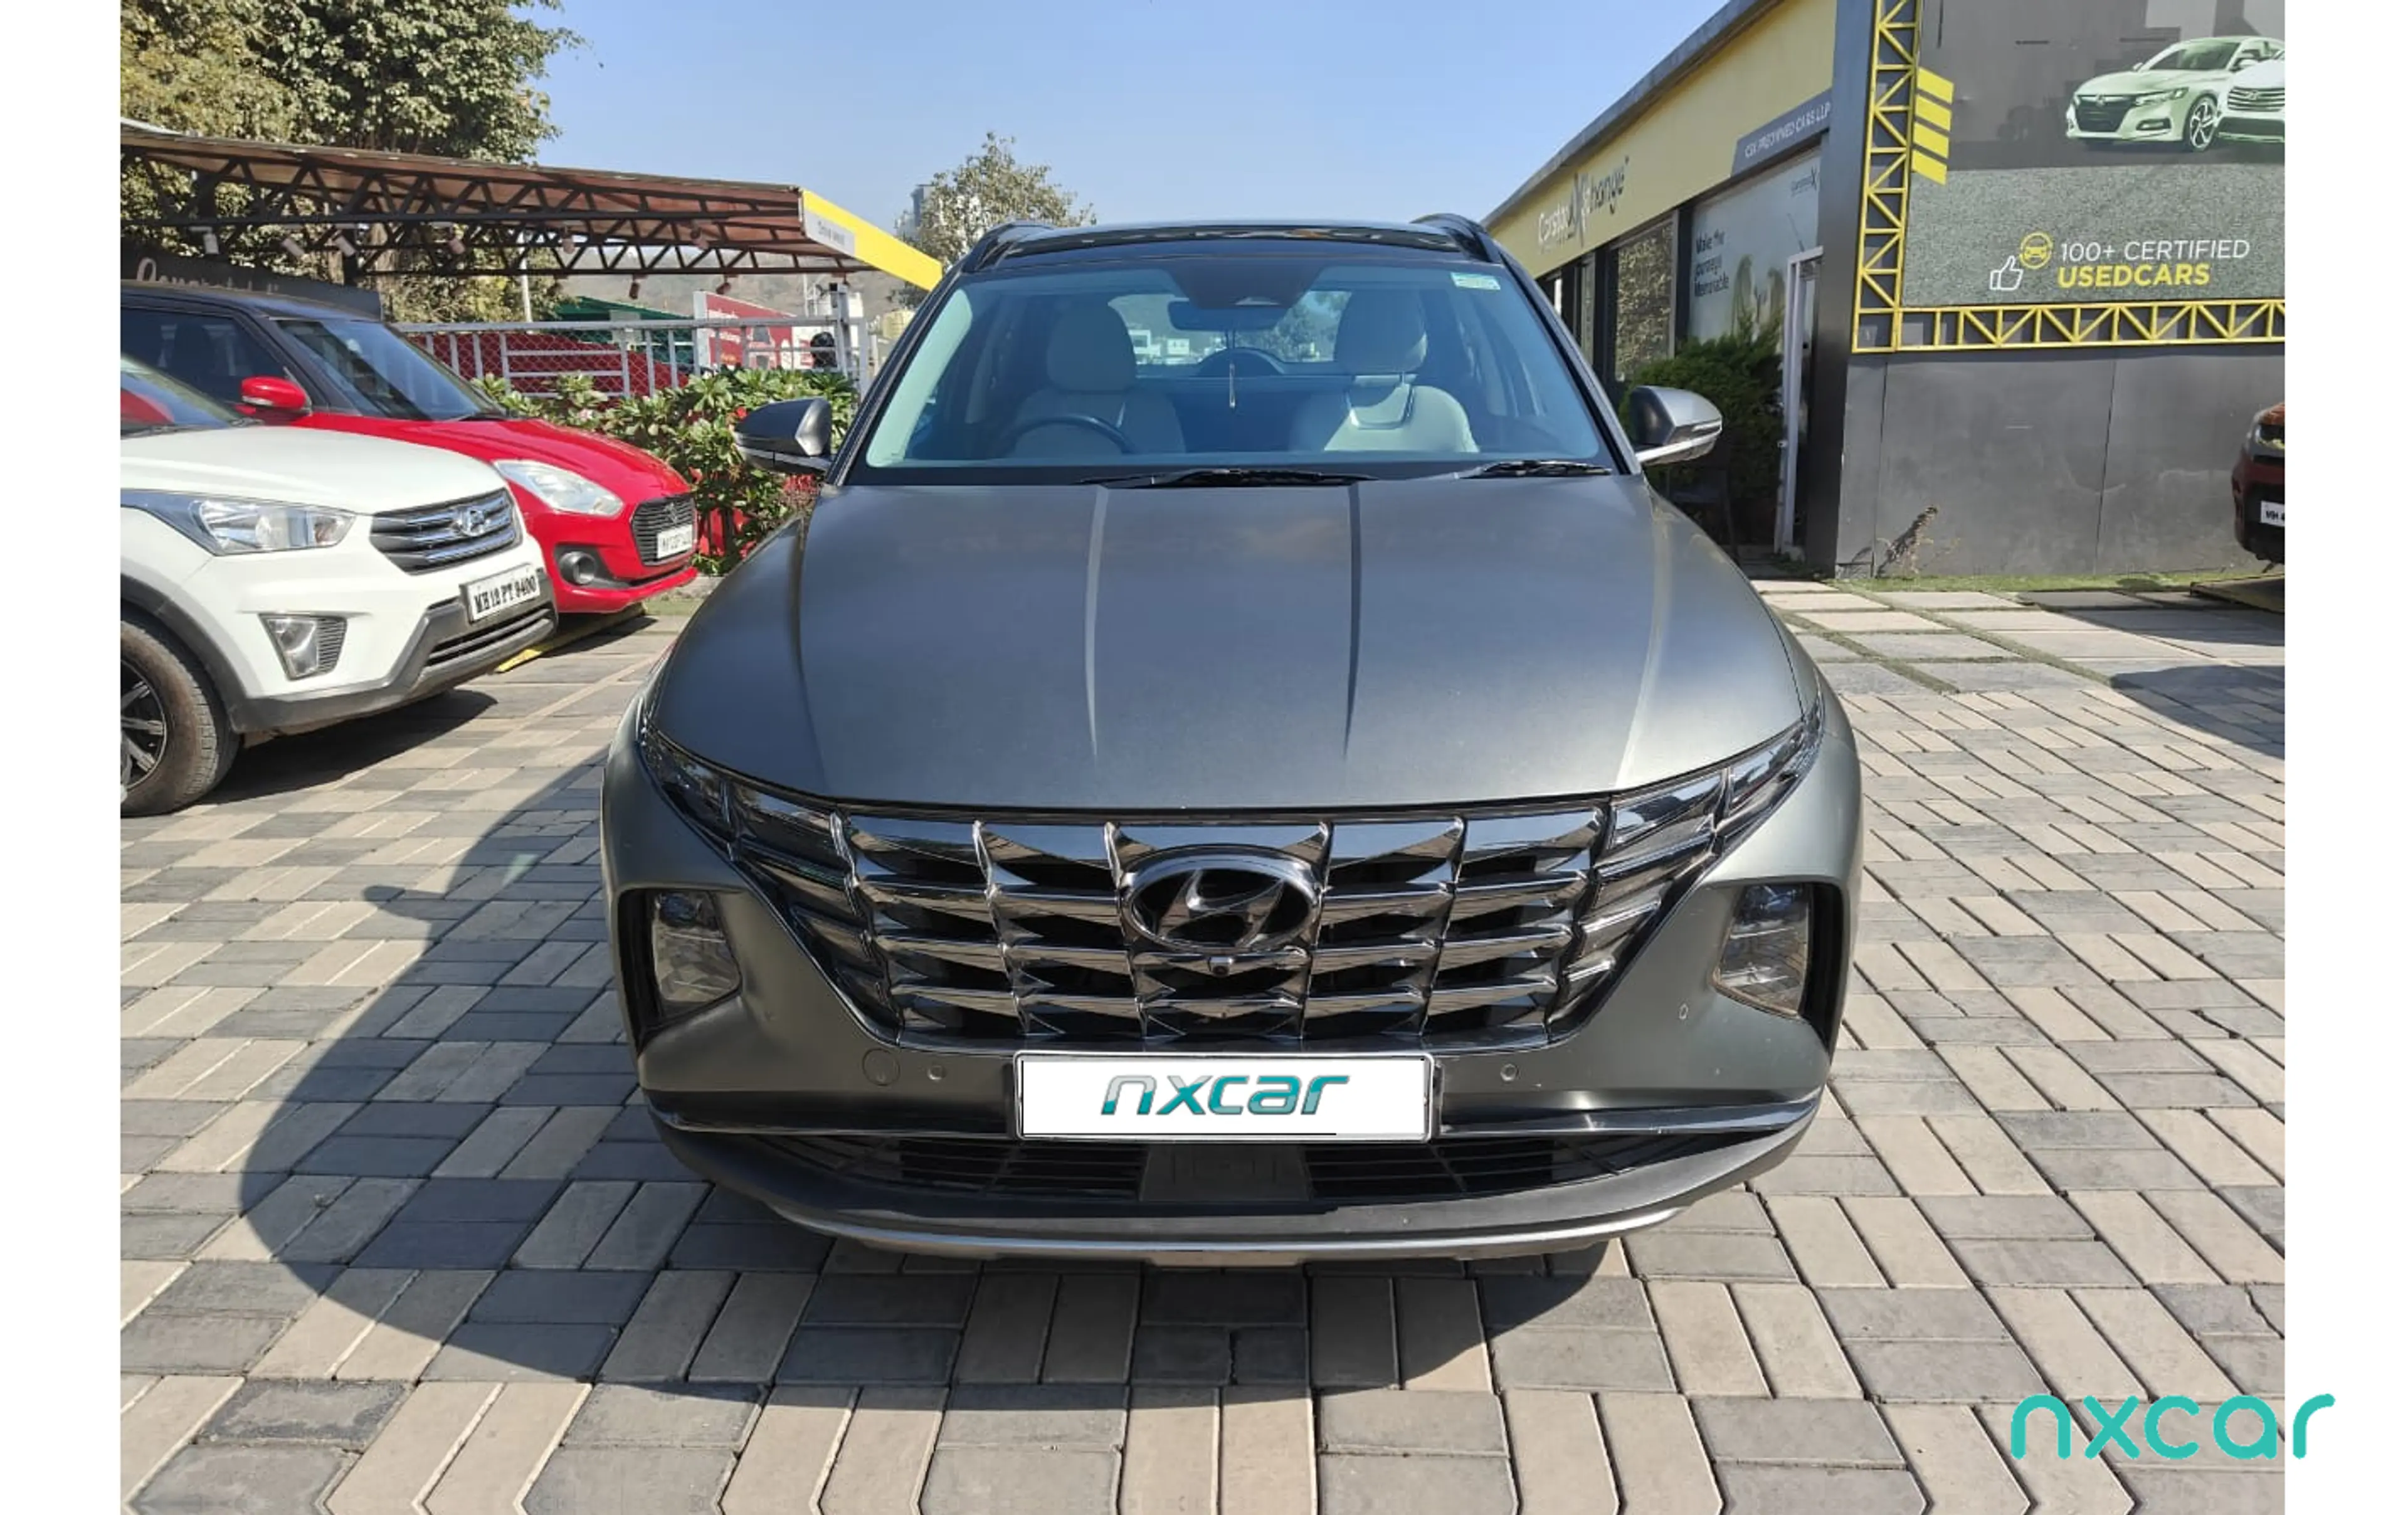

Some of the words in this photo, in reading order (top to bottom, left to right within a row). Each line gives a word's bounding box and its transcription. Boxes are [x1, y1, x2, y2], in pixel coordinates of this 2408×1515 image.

[2061, 242, 2116, 261] 100+
[2125, 240, 2251, 260] CERTIFIED
[2058, 263, 2210, 288] USEDCARS
